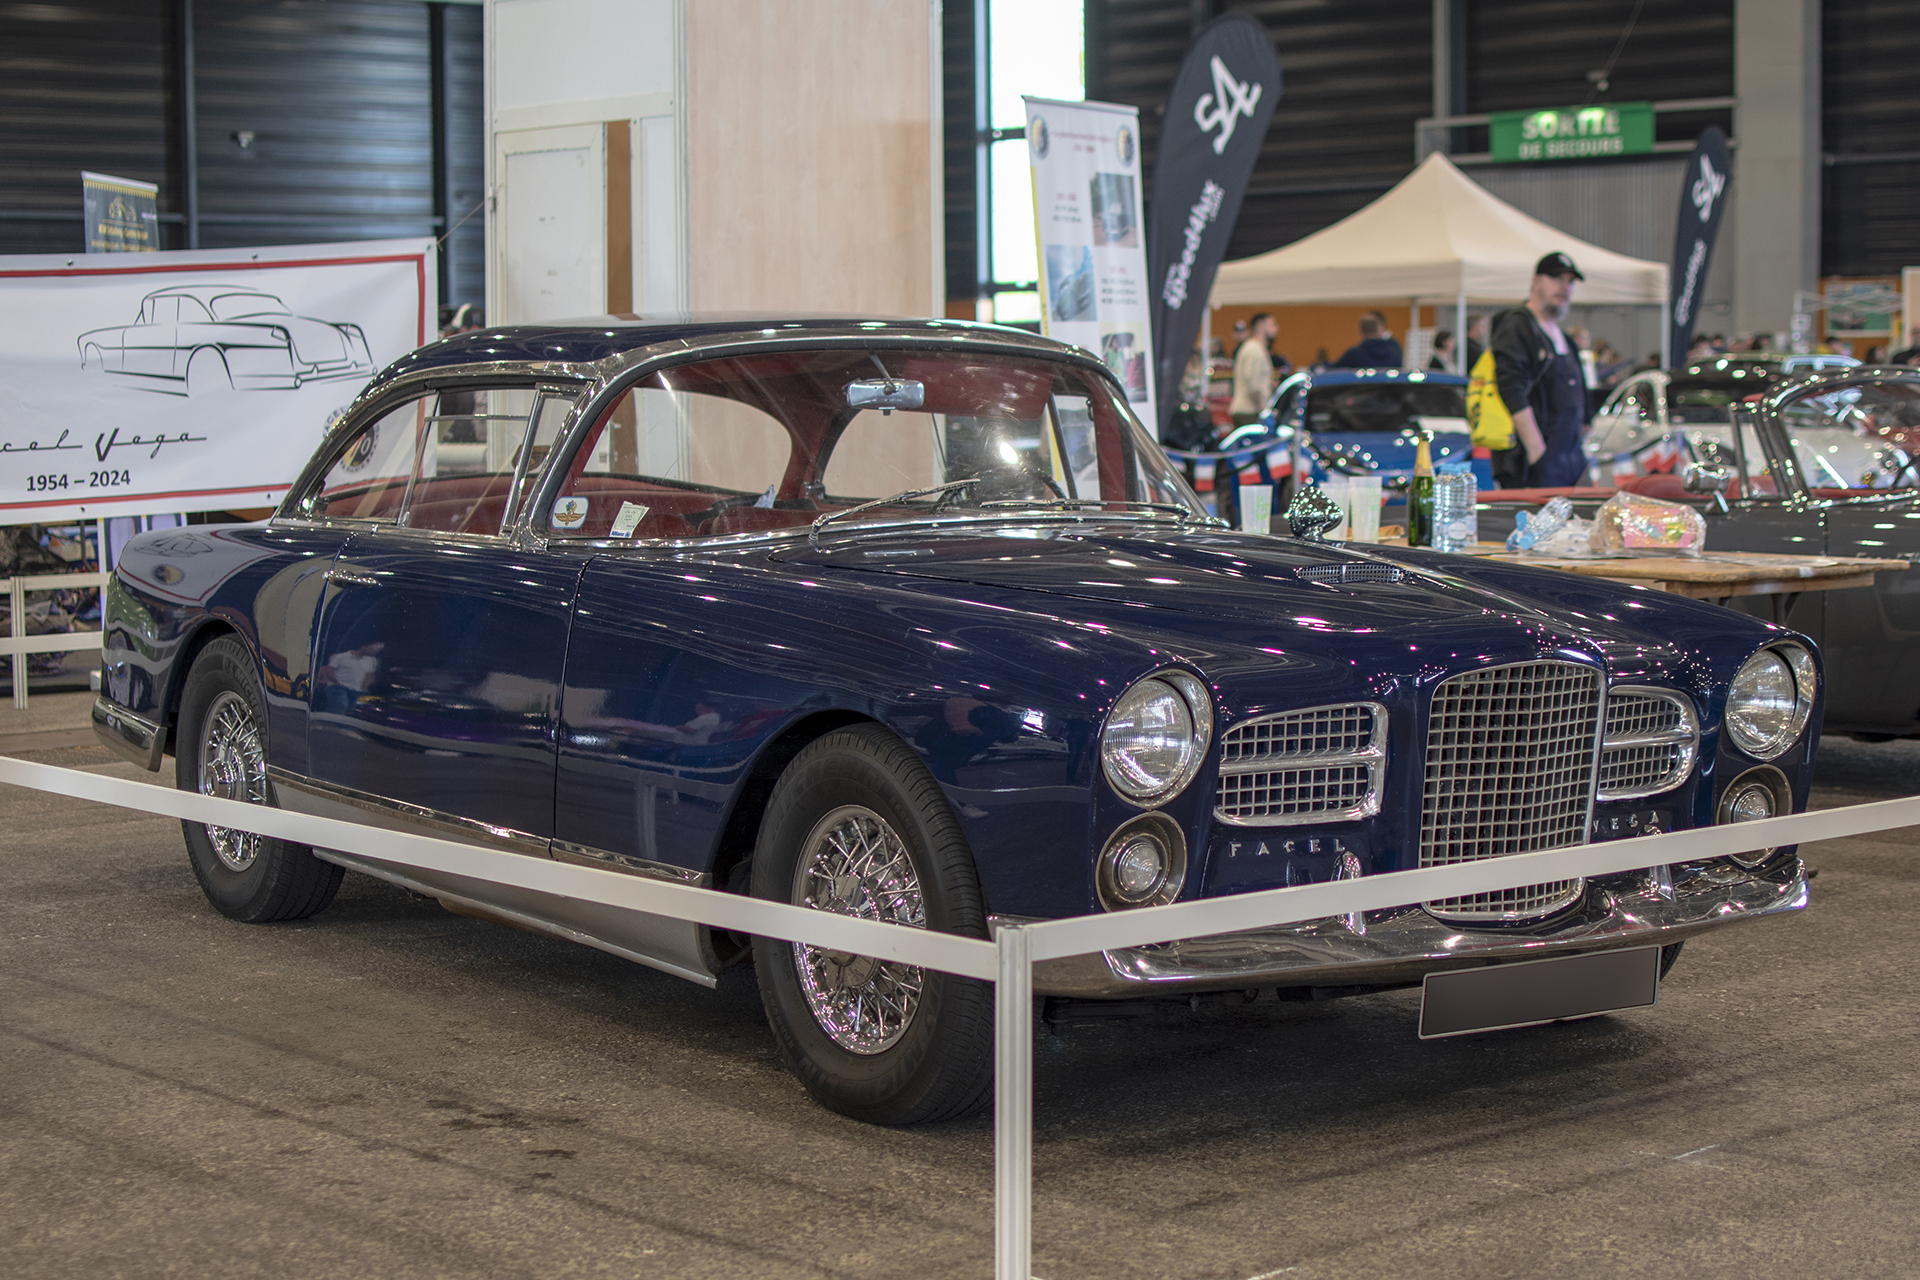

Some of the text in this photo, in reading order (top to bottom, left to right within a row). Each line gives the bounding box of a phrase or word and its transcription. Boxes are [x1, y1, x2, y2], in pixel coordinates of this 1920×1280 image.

[1522, 110, 1620, 139] SORTIE
[1519, 136, 1624, 159] DE SECOURS
[26, 474, 69, 491] 1954
[89, 469, 131, 488] 2024
[1593, 810, 1659, 833] VEGA
[1229, 839, 1345, 857] FACEL
[766, 990, 795, 1049] HARMONY
